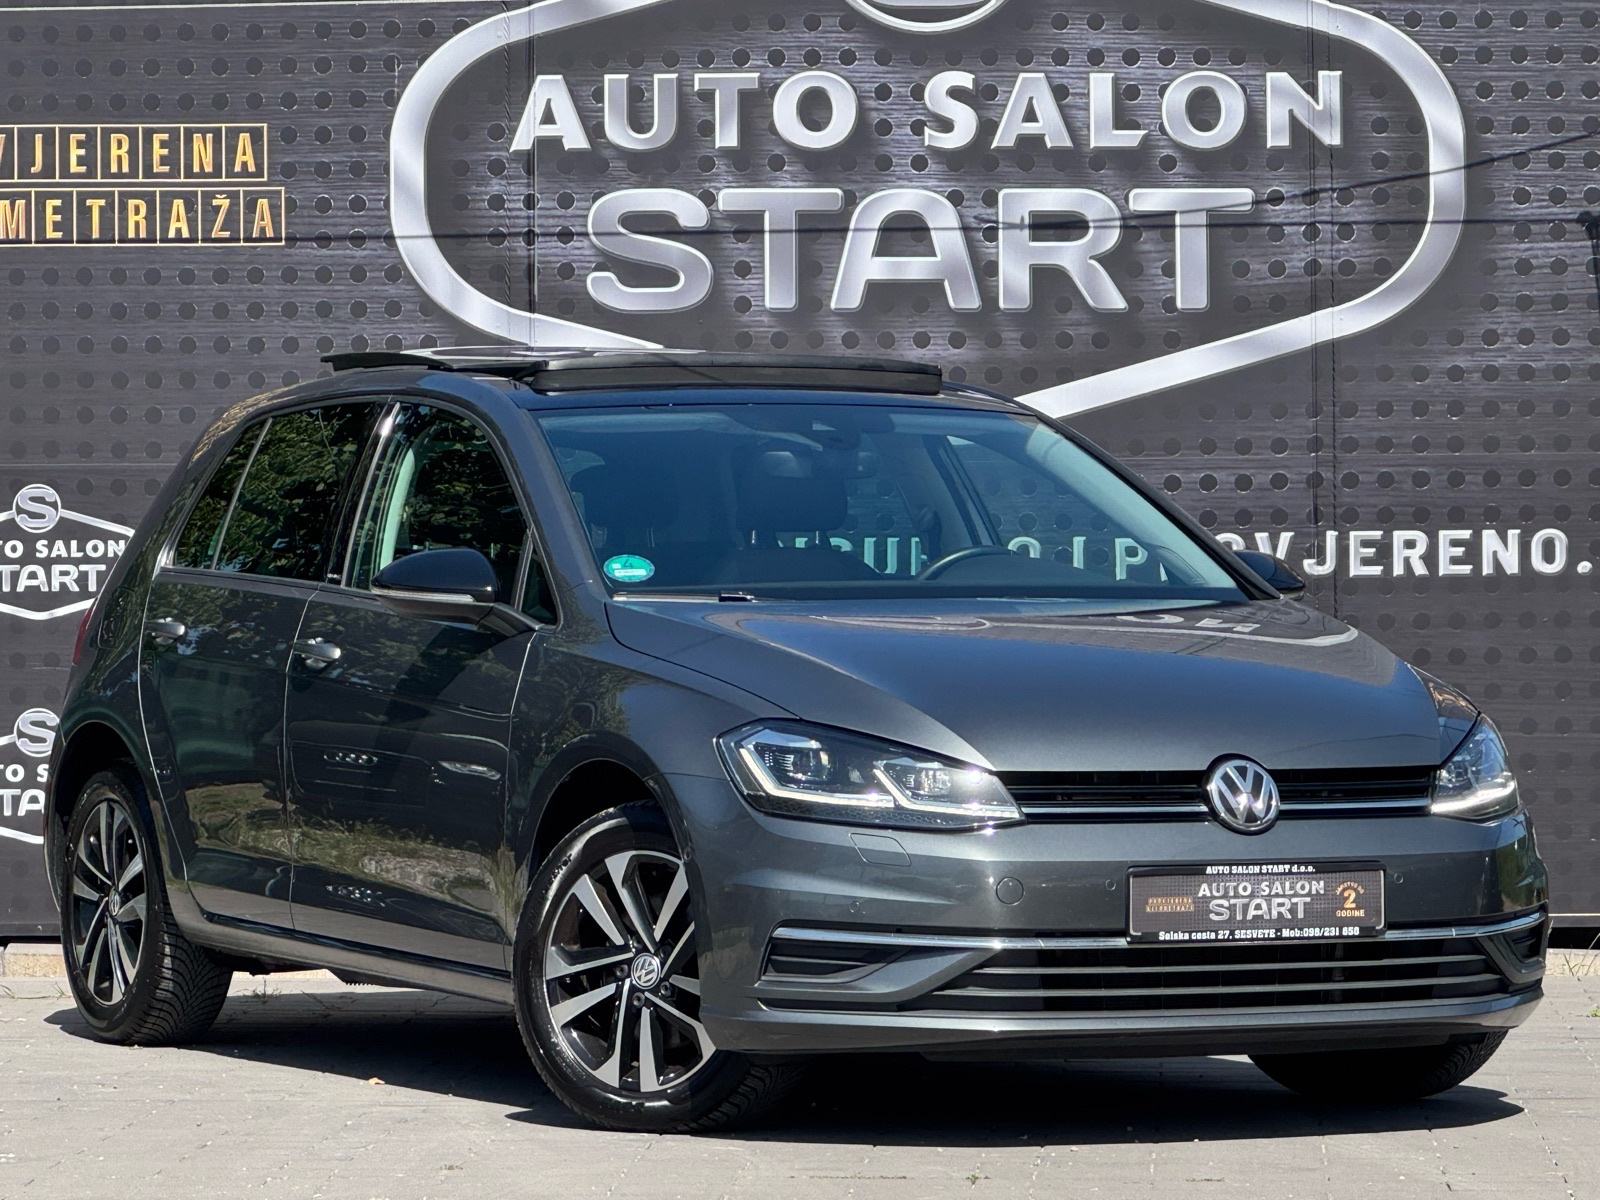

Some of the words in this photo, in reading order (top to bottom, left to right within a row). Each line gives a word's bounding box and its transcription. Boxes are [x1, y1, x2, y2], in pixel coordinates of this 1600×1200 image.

[508, 71, 858, 153] AUTO
[923, 70, 1344, 150] SALON
[0, 194, 275, 240] METRAŽA
[586, 187, 1256, 313] START
[0, 539, 24, 558] O
[35, 539, 126, 558] SALON
[1206, 866, 1229, 875] AUTO
[1231, 865, 1260, 874] SALON
[1261, 864, 1290, 873] START
[1197, 882, 1252, 897] AUTO
[1260, 880, 1325, 896] SALON
[1343, 889, 1356, 908] 2
[1209, 897, 1311, 921] START
[1335, 909, 1365, 917] GODINE
[1234, 929, 1276, 939] SESVETE
